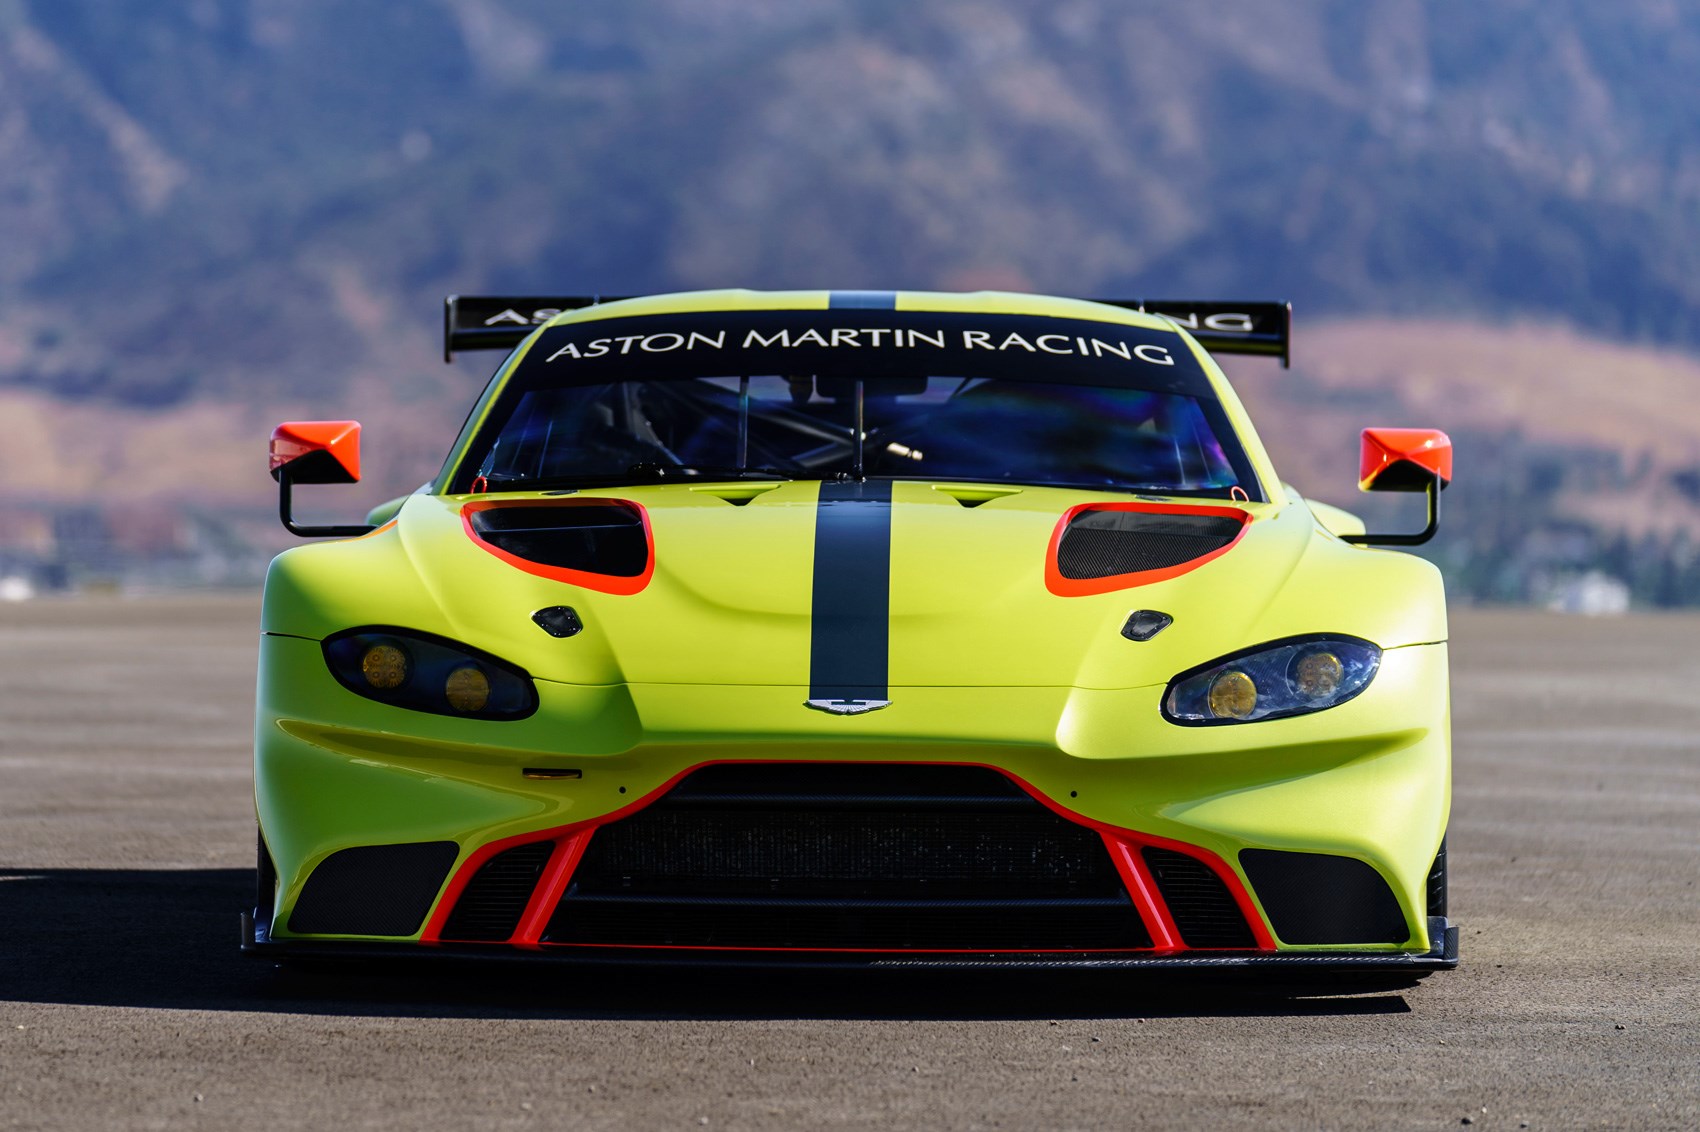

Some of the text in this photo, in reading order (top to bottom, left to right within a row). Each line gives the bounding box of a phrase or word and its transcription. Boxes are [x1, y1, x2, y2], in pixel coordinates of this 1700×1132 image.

[545, 328, 1175, 366] ASTON MARTIN RACING
